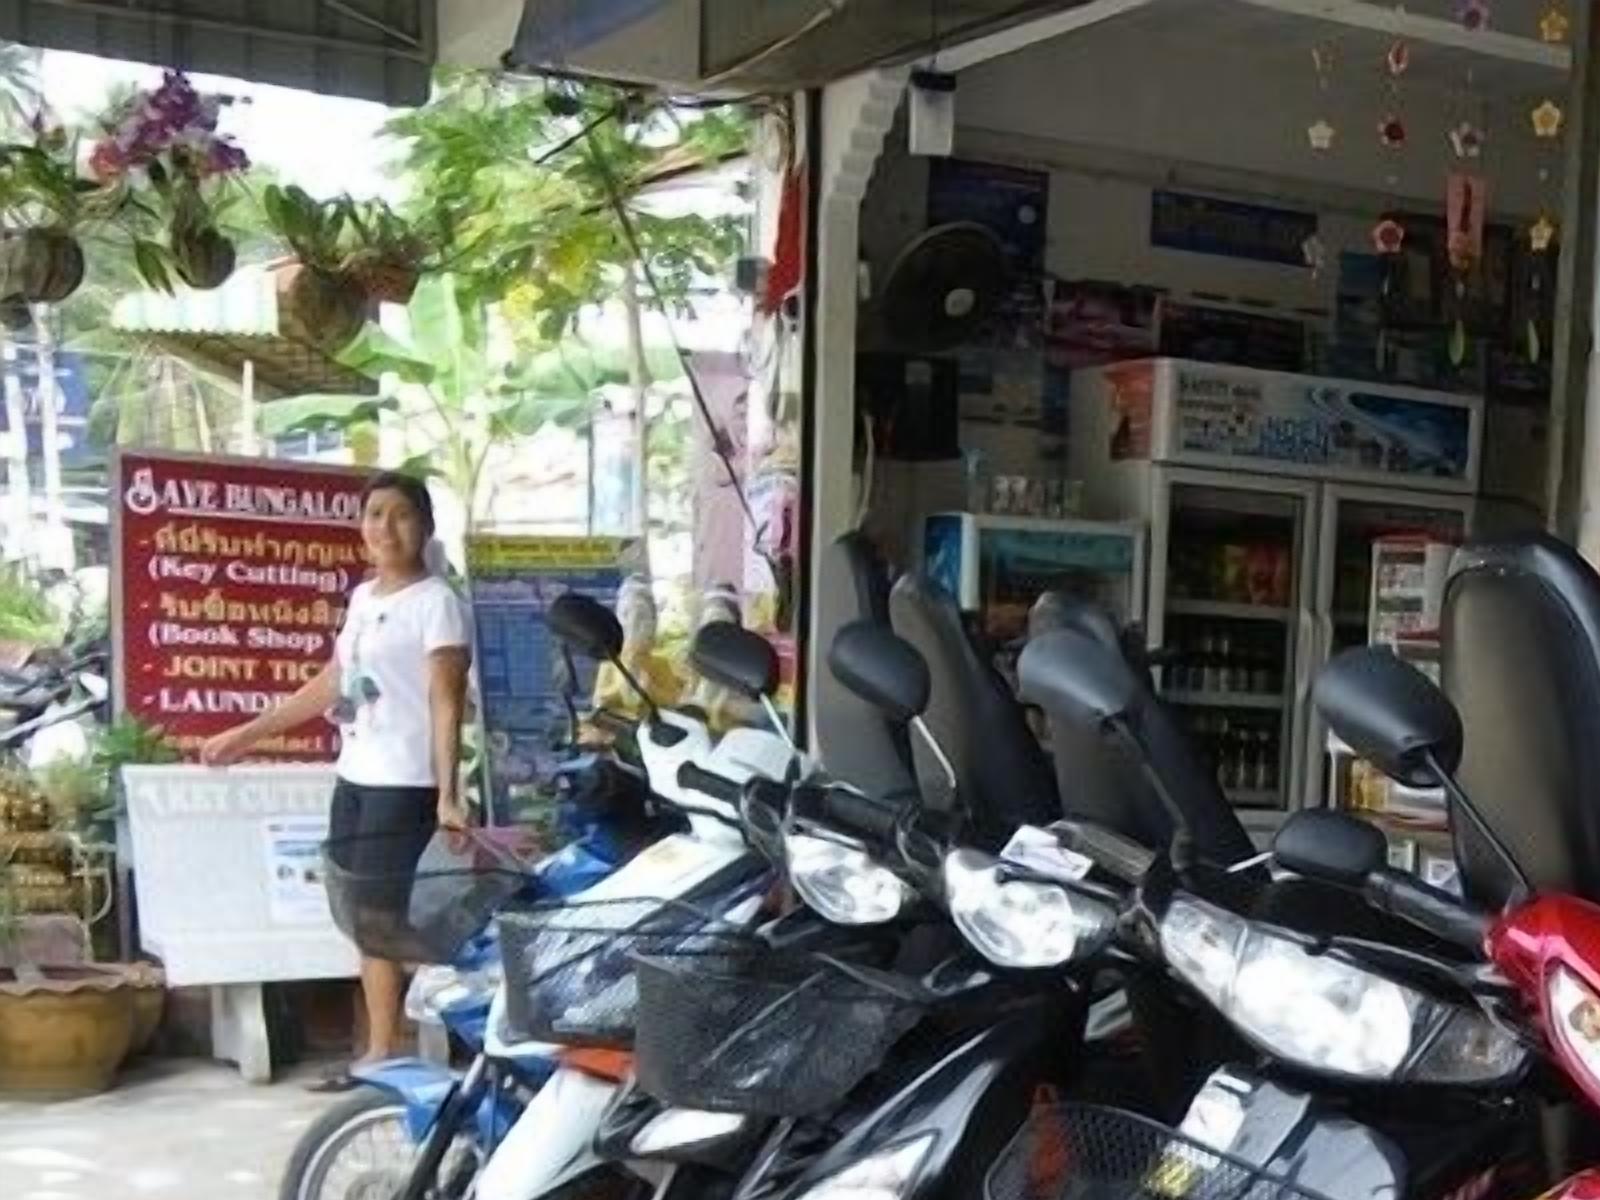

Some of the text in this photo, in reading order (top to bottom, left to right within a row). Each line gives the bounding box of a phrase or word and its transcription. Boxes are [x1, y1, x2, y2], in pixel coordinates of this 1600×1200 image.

[148, 553, 349, 594] (Key Cutting)
[148, 621, 324, 654] (Book Shop
[163, 655, 257, 682] JOINT
